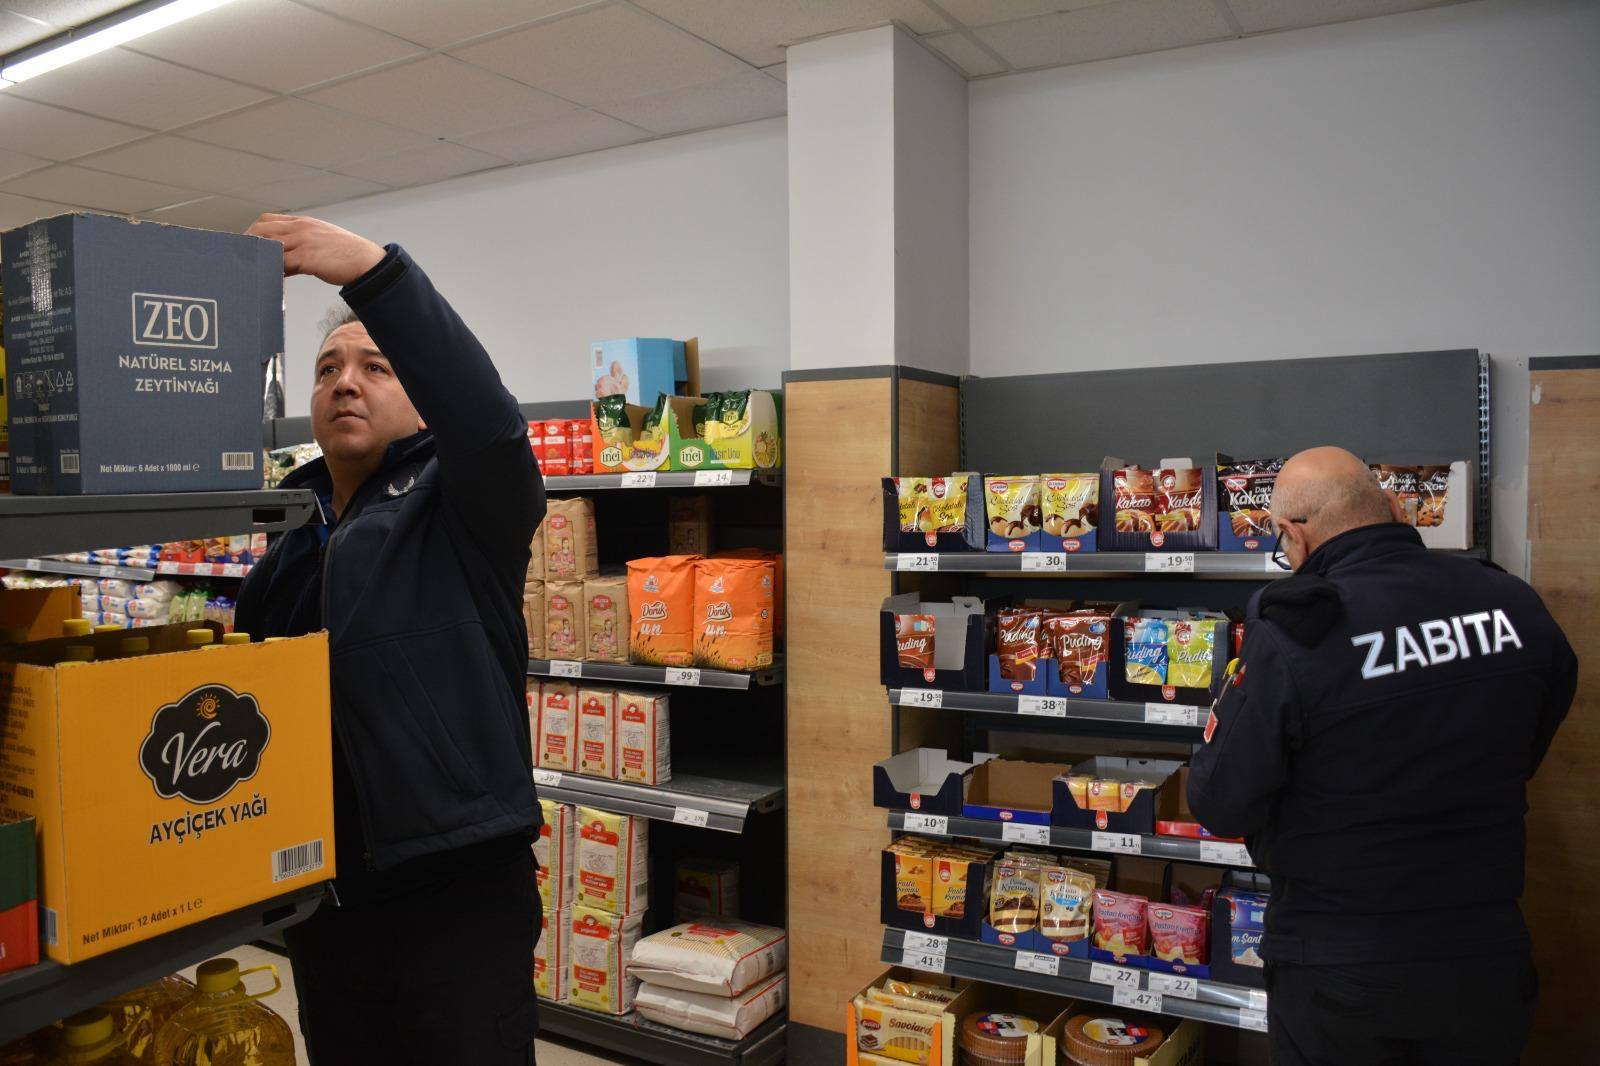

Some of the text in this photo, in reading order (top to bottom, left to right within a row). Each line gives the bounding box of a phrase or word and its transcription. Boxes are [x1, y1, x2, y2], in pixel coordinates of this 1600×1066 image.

[142, 300, 209, 342] ZEO
[119, 354, 232, 374] NATÜREL SIZMA
[135, 377, 219, 394] ZEYTİNYAĞI
[602, 450, 620, 463] inci
[682, 450, 702, 463] inci
[100, 464, 115, 473] Net
[144, 463, 159, 472] Adet
[165, 463, 182, 472] 1000
[183, 463, 191, 471] ml
[1116, 496, 1151, 509] Kakao
[1045, 556, 1060, 566] 30
[642, 603, 668, 619] Doruk
[707, 603, 732, 619] Doruk
[896, 637, 927, 654] uding
[1060, 633, 1104, 650] Puding
[1350, 608, 1522, 680] ZABITA
[161, 721, 248, 785] Vera
[149, 793, 268, 845] AYÇİÇEK YAĞI
[1120, 836, 1136, 848] 11
[83, 932, 99, 945] Net
[103, 922, 135, 938] Miktar:
[137, 915, 149, 927] 12
[150, 909, 171, 924] Adet
[1116, 970, 1132, 982] 27
[1175, 980, 1190, 991] 27
